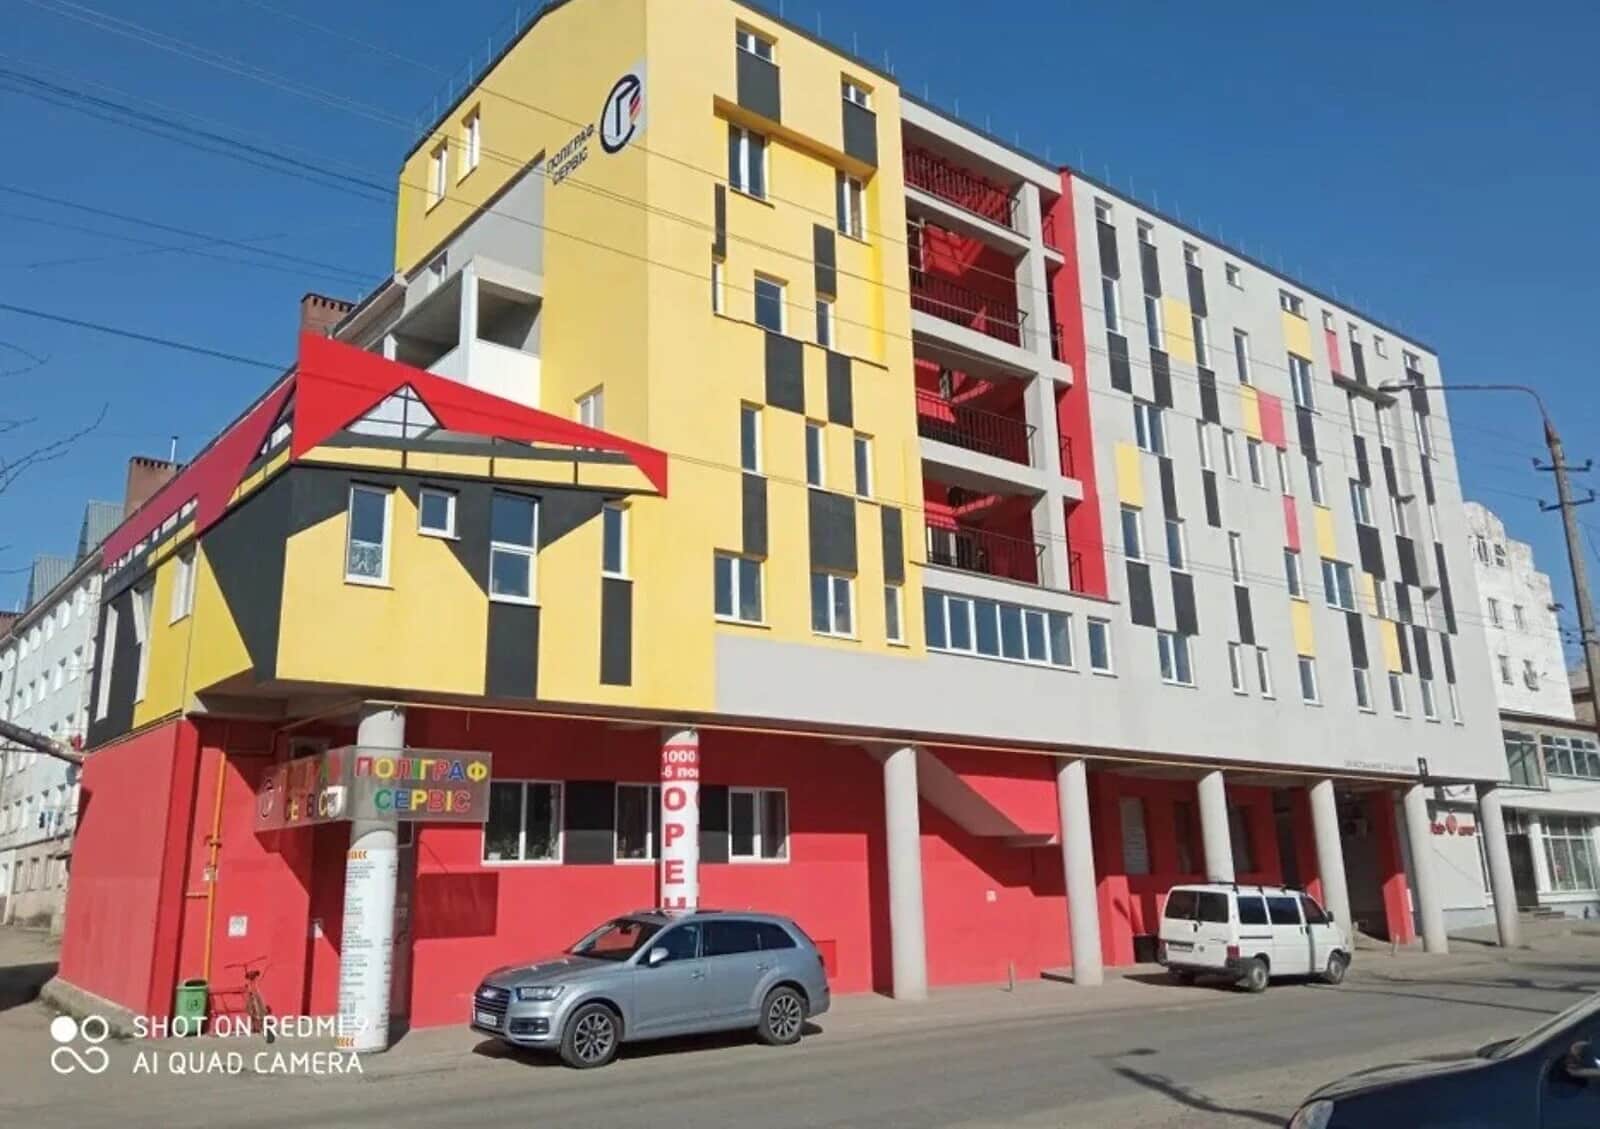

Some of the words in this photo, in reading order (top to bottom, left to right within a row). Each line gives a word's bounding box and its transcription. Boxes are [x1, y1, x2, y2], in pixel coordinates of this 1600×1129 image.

[552, 147, 589, 185] СЕРВІС
[356, 755, 488, 782] ПОЛІГРАФ
[662, 750, 696, 764] 1000
[373, 788, 472, 813] СЕРВІС
